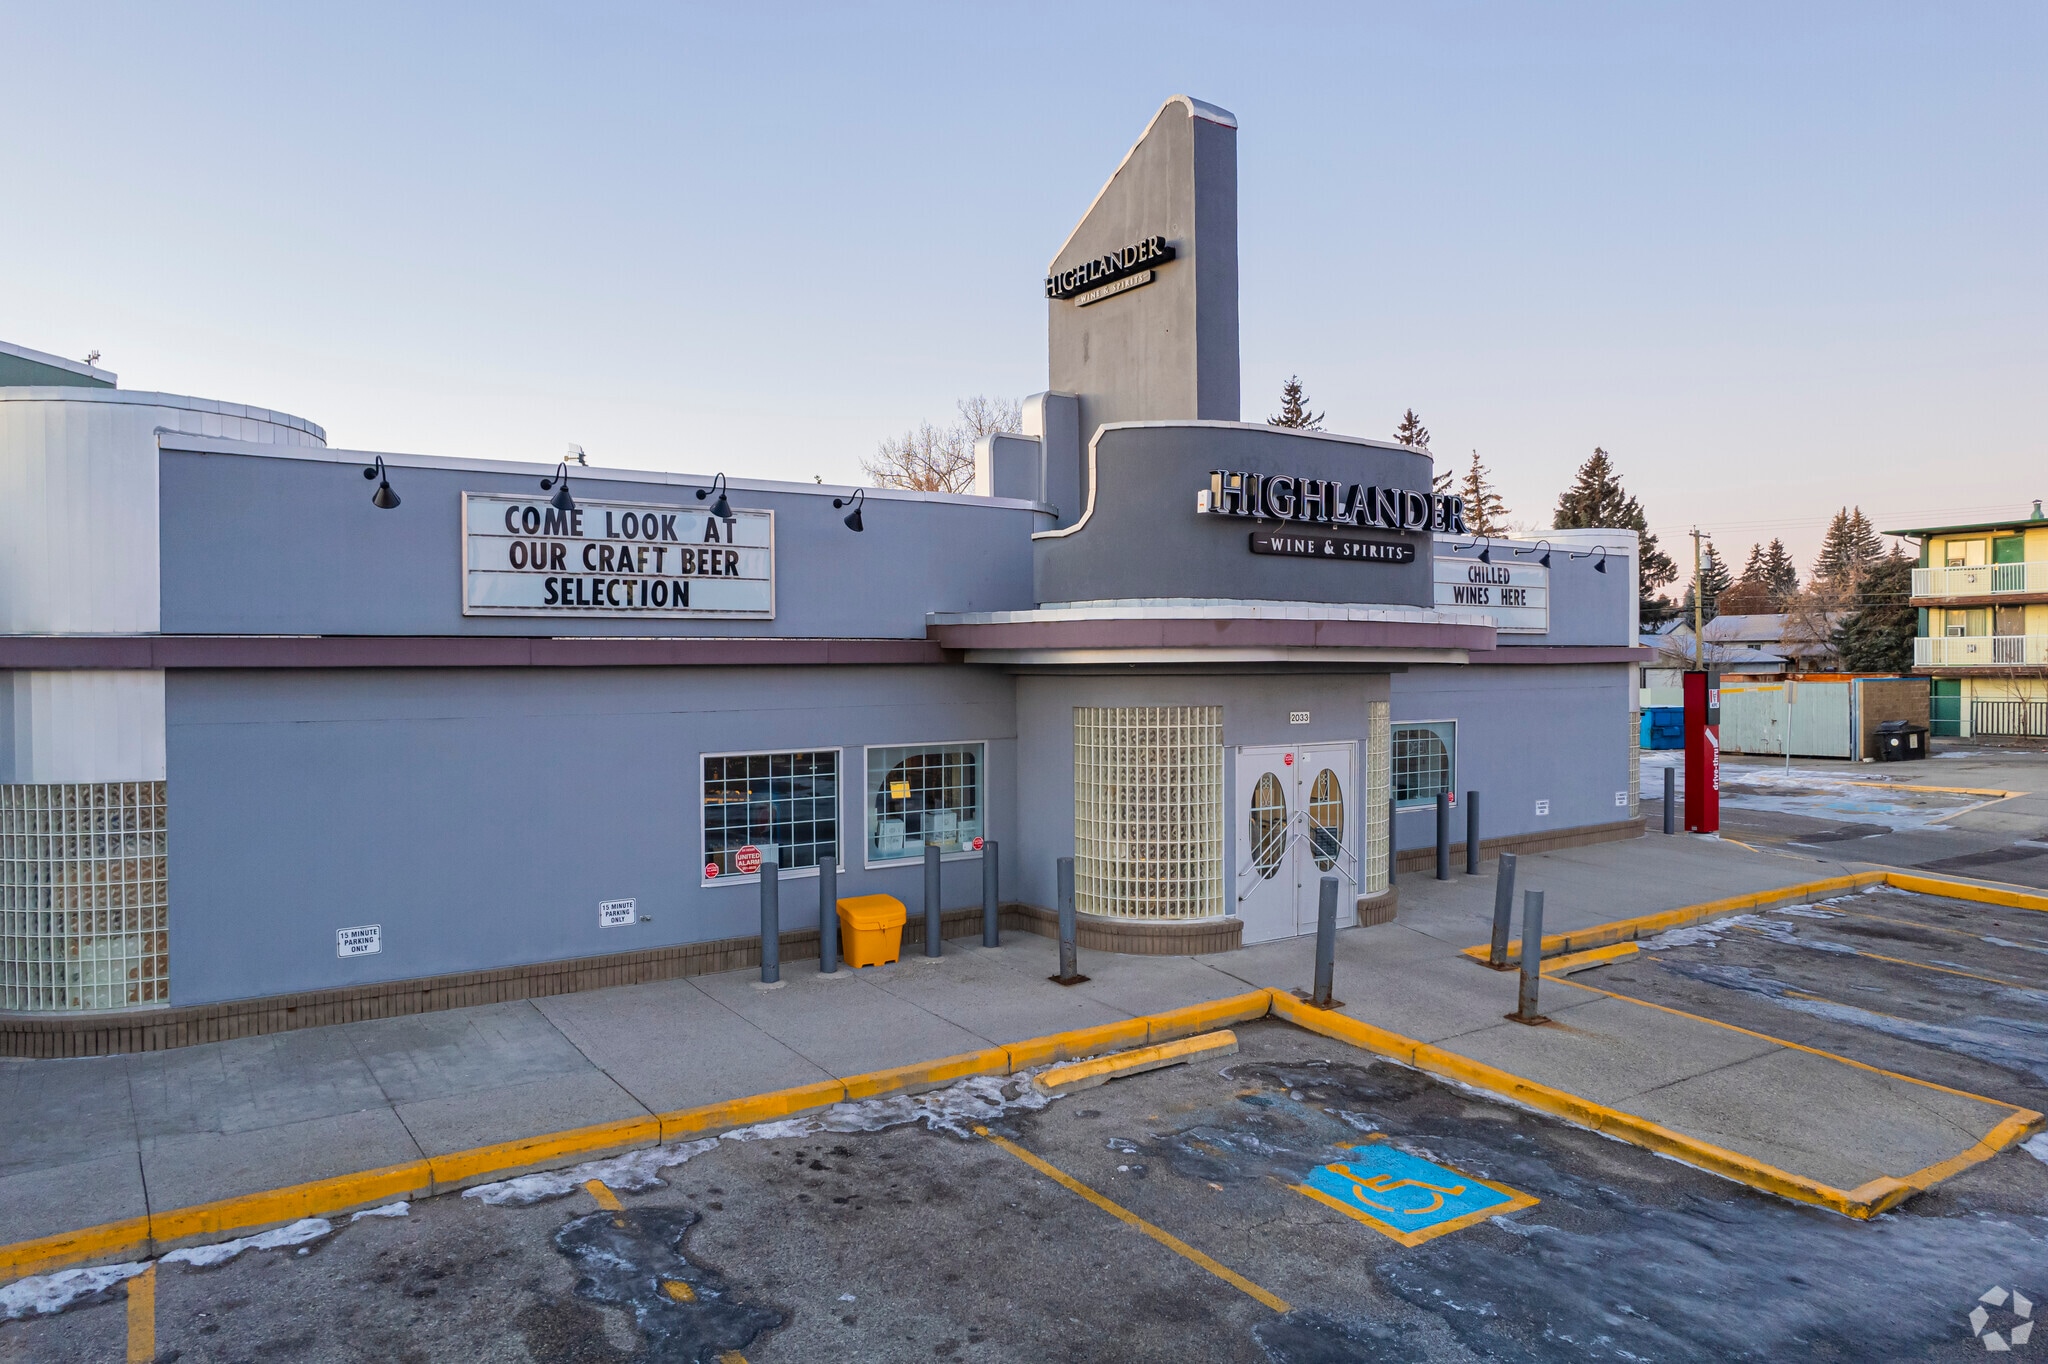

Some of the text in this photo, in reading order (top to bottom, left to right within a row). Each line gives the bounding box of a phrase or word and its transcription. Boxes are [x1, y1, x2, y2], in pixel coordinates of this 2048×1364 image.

[1044, 235, 1164, 298] HIGHLANDER
[1080, 290, 1100, 302] WINE
[1112, 275, 1143, 292] SPIRITS
[1213, 469, 1471, 534] HIGHLANDER
[505, 506, 737, 543] COME LOOK AT
[509, 541, 739, 576] OUR CRAFT BEER
[1270, 538, 1403, 560] WINE & SPIRITS
[1468, 565, 1510, 584] CHILLED
[544, 577, 690, 607] SELECTION
[1453, 586, 1527, 606] WINES HERE
[344, 937, 374, 946] PARKING
[351, 929, 378, 937] MINUTE
